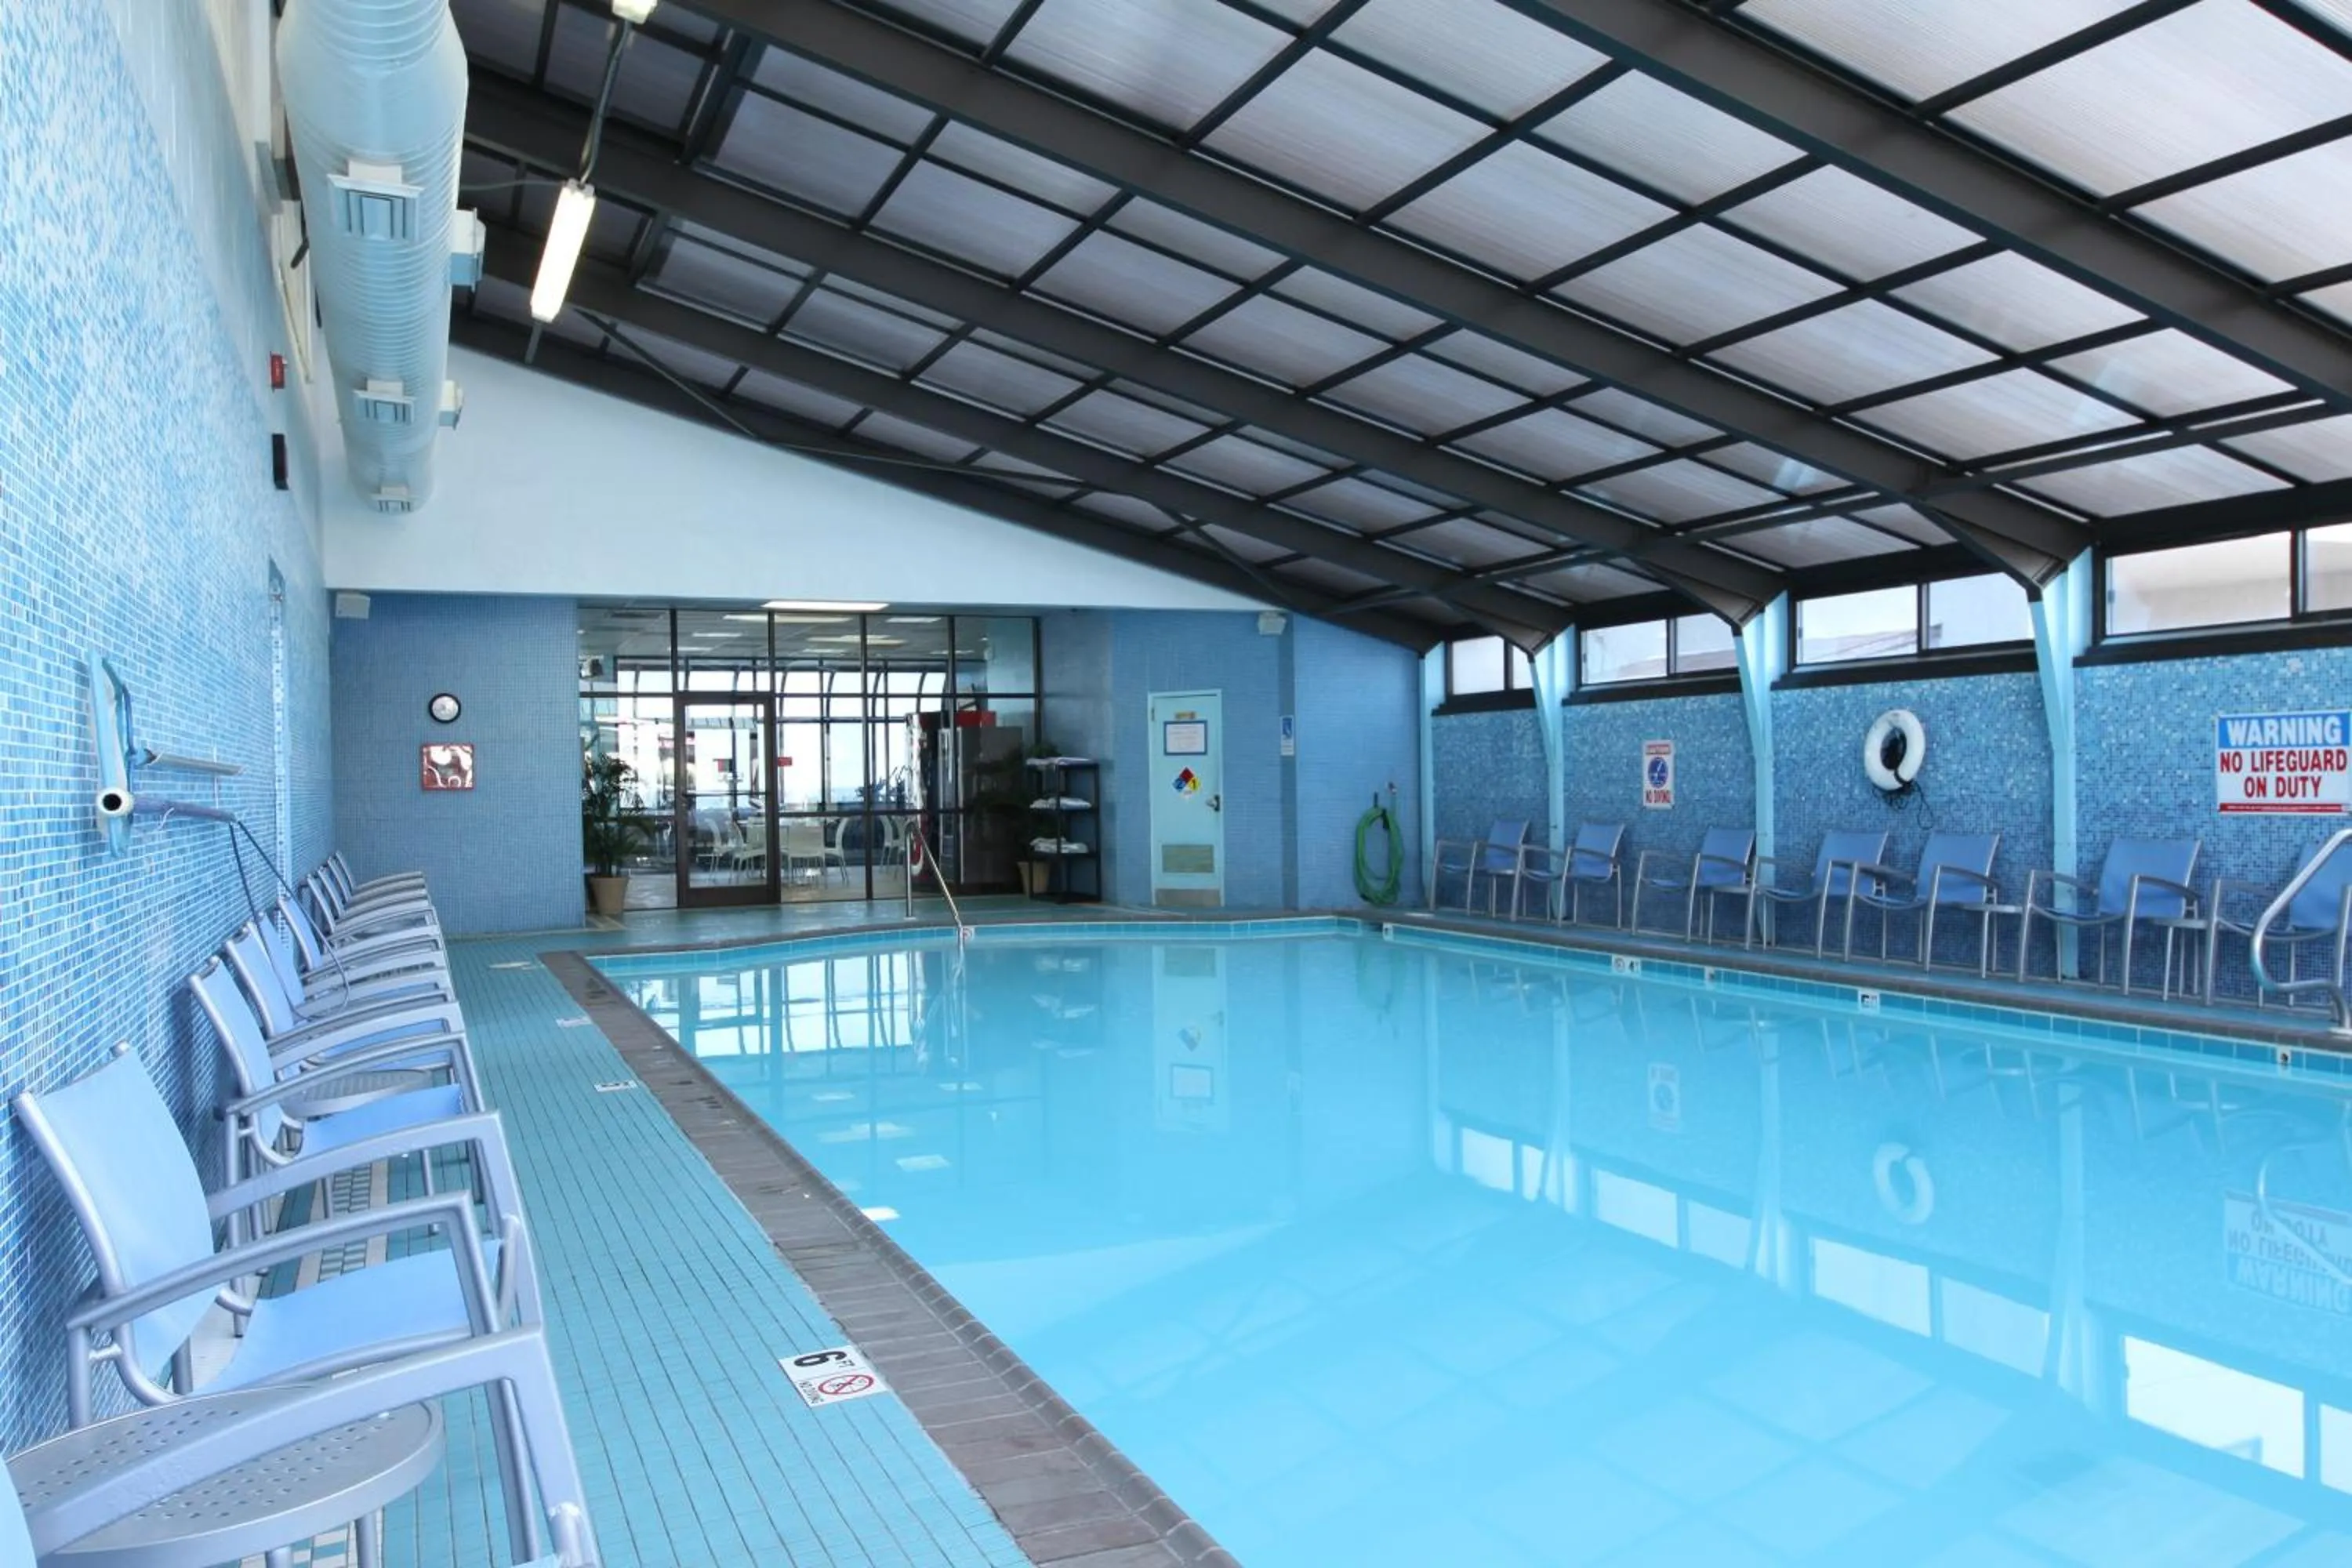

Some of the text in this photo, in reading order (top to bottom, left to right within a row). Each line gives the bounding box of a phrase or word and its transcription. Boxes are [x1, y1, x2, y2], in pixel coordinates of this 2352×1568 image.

[2227, 715, 2342, 746] WARNING
[2220, 749, 2347, 772] NO LIFEGUARD
[2244, 775, 2321, 798] ON DUTY
[793, 1351, 847, 1367] 6
